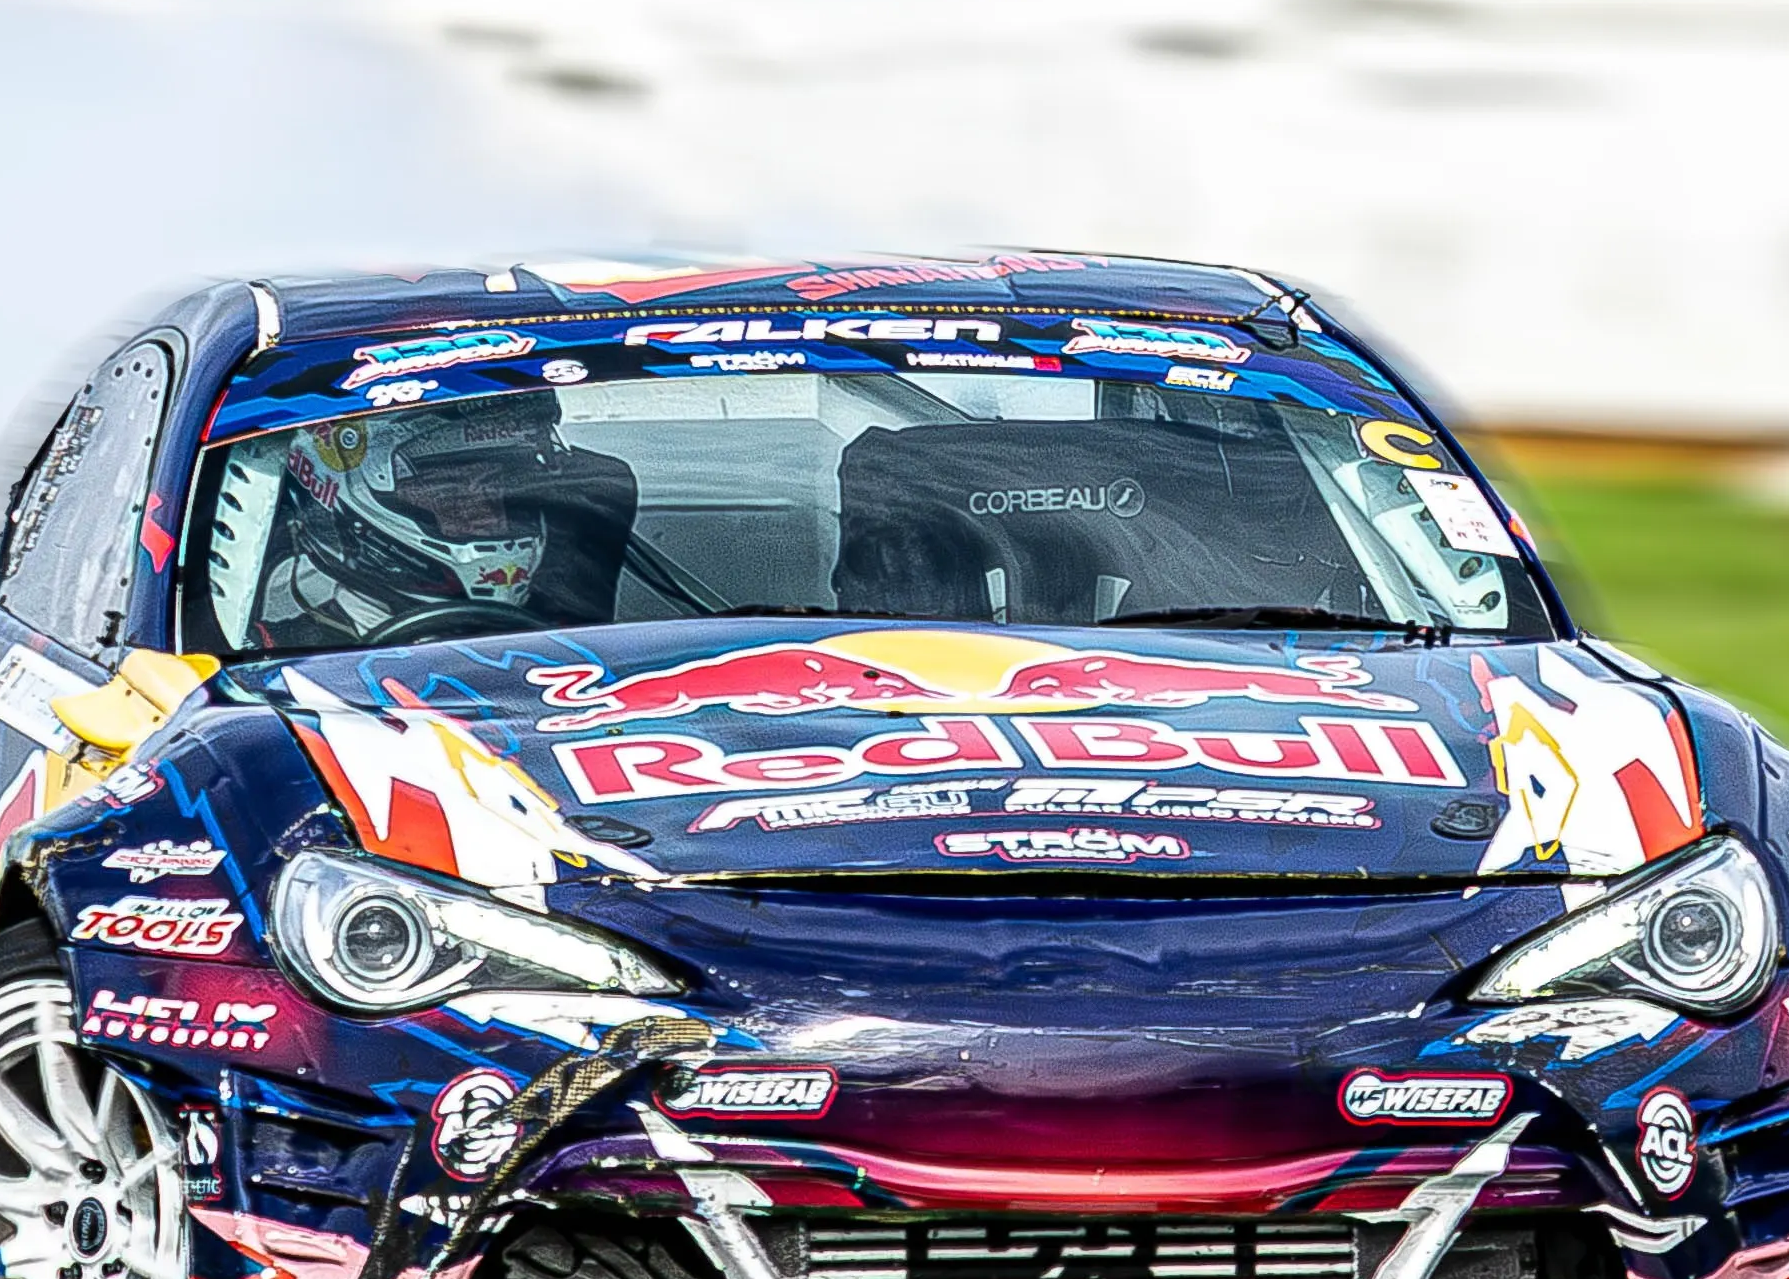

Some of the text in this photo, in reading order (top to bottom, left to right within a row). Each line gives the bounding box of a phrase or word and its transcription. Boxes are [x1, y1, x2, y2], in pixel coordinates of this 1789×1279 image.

[625, 319, 1000, 345] FALKEN
[1361, 420, 1442, 469] C
[969, 488, 1105, 513] CORBEAU
[556, 715, 1469, 802] Red Bull
[1133, 806, 1233, 818] TURBO
[943, 828, 1180, 856] STRÖM
[81, 911, 234, 946] TOOLS
[83, 1016, 271, 1050] AUTOSPORT
[701, 1079, 832, 1104] WISEFAB
[1383, 1088, 1506, 1111] WISEFAB
[1641, 1125, 1693, 1162] ACL
